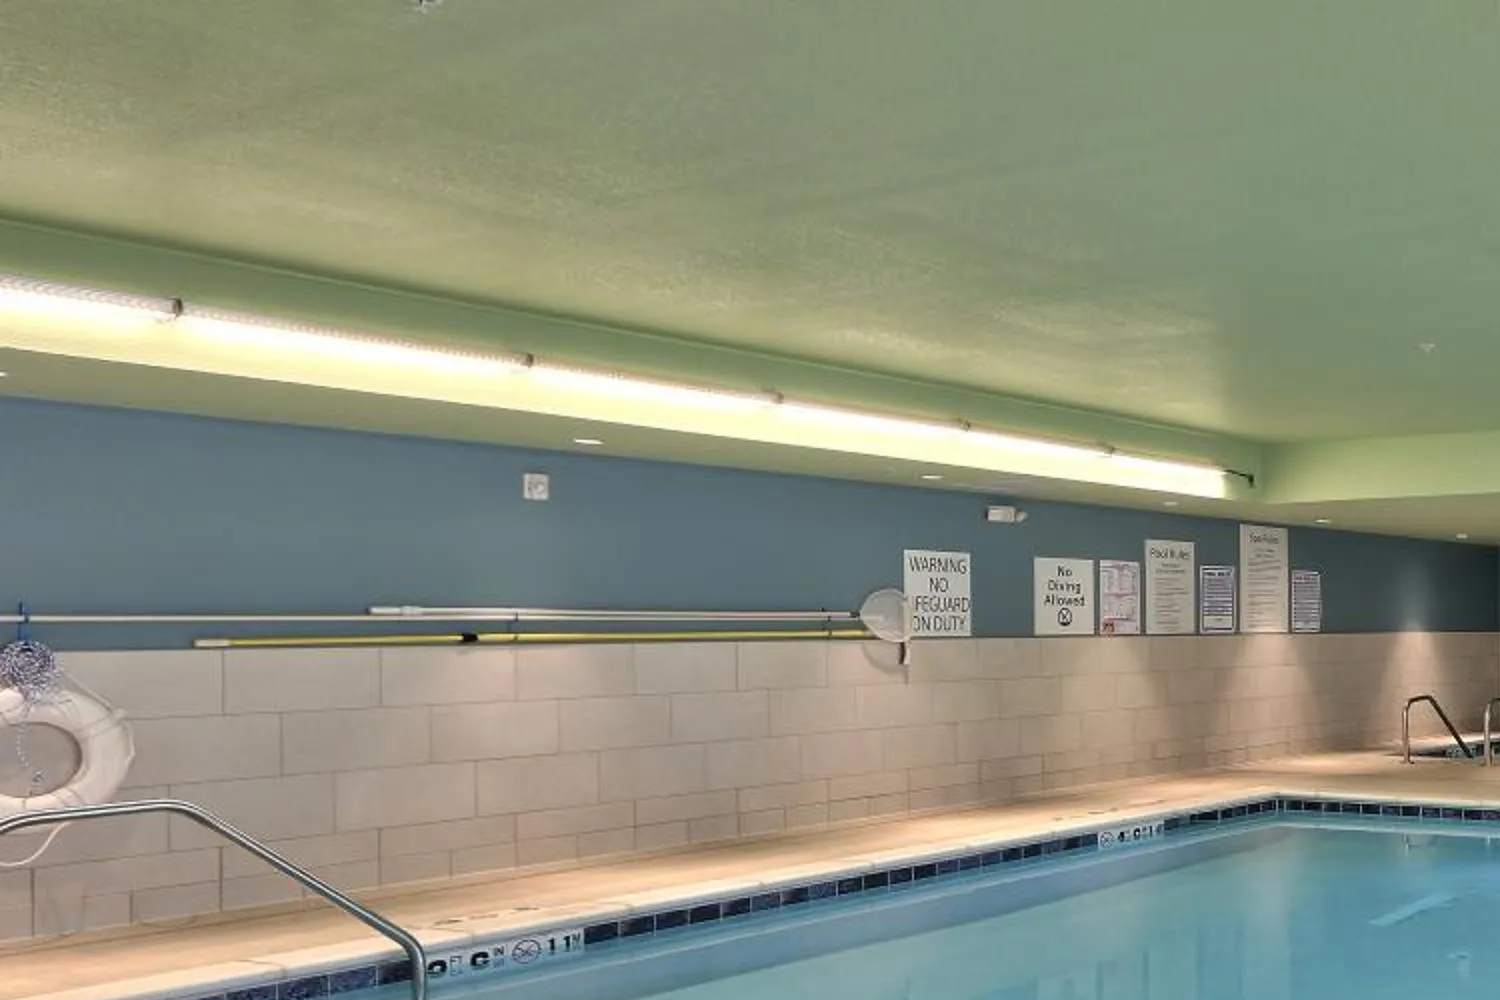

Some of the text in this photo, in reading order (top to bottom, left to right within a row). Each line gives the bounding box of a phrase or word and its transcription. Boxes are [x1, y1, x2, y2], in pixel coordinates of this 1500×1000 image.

[909, 556, 968, 574] WARNING
[1057, 565, 1073, 577] No
[929, 577, 949, 593] NO
[1047, 579, 1081, 594] Diving
[911, 595, 970, 613] IFEGUARD
[1044, 595, 1085, 607] Allowed
[911, 615, 931, 632] ON
[933, 615, 967, 631] DUTY
